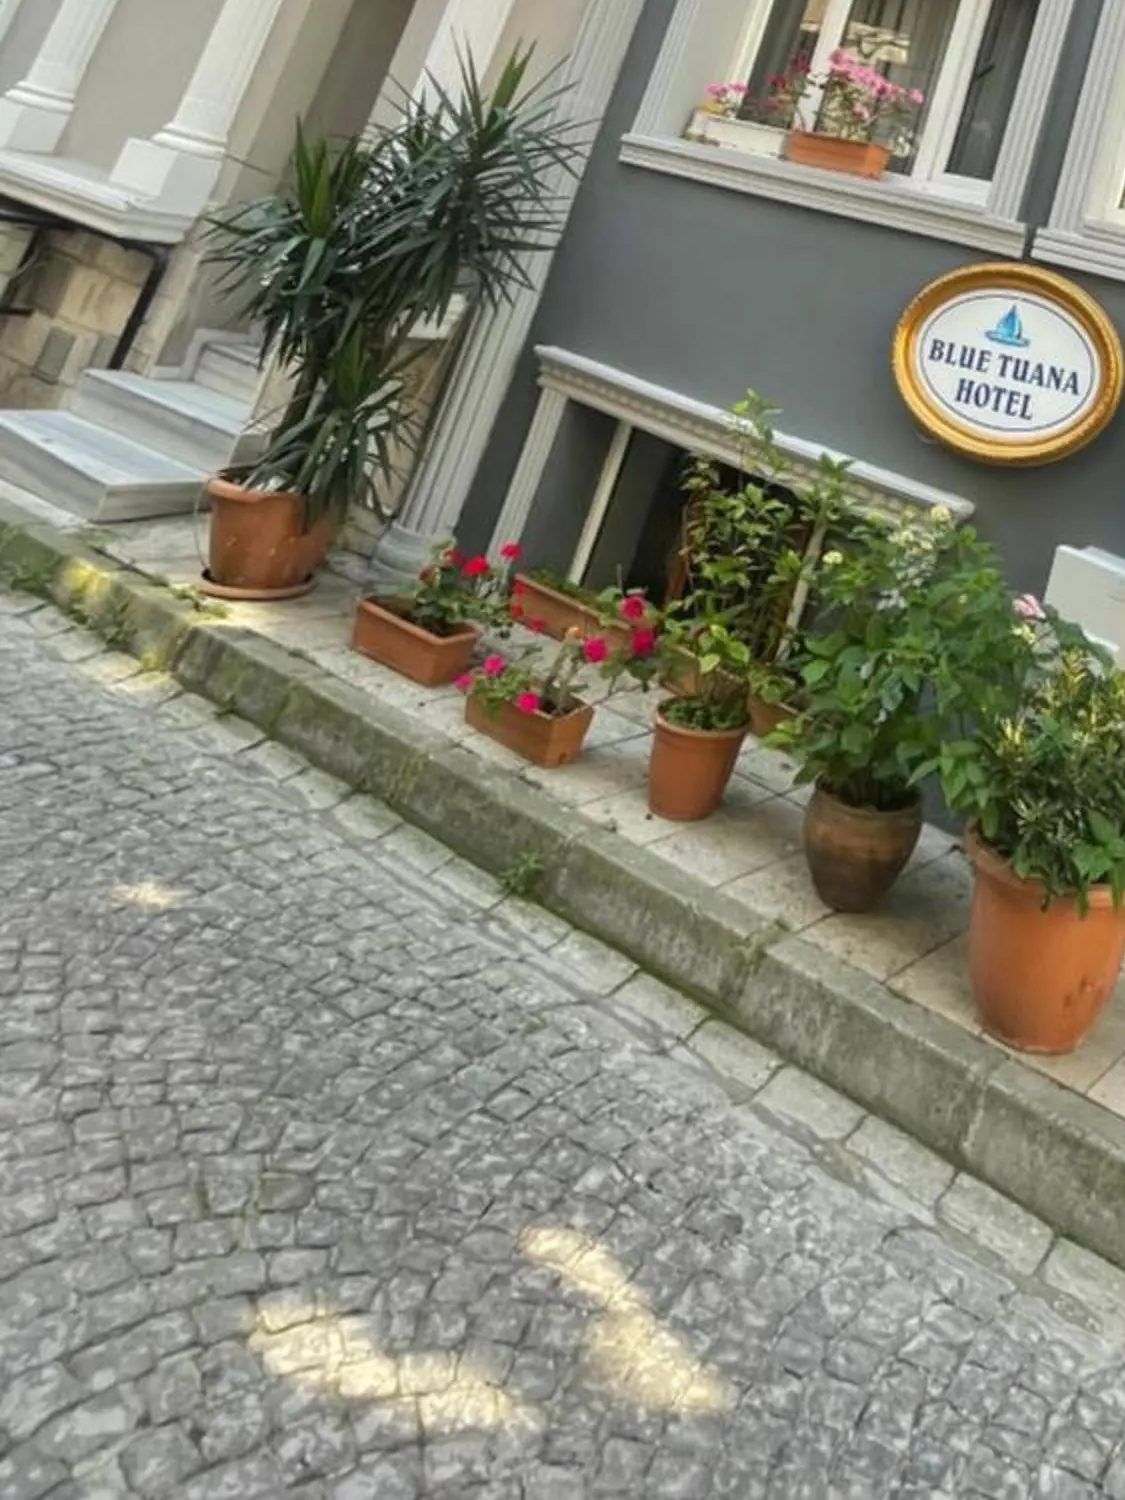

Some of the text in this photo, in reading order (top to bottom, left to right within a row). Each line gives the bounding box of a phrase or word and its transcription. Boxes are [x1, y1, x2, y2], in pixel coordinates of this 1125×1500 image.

[929, 338, 1080, 396] BLUE TUANA
[956, 377, 1033, 421] HOTEL
